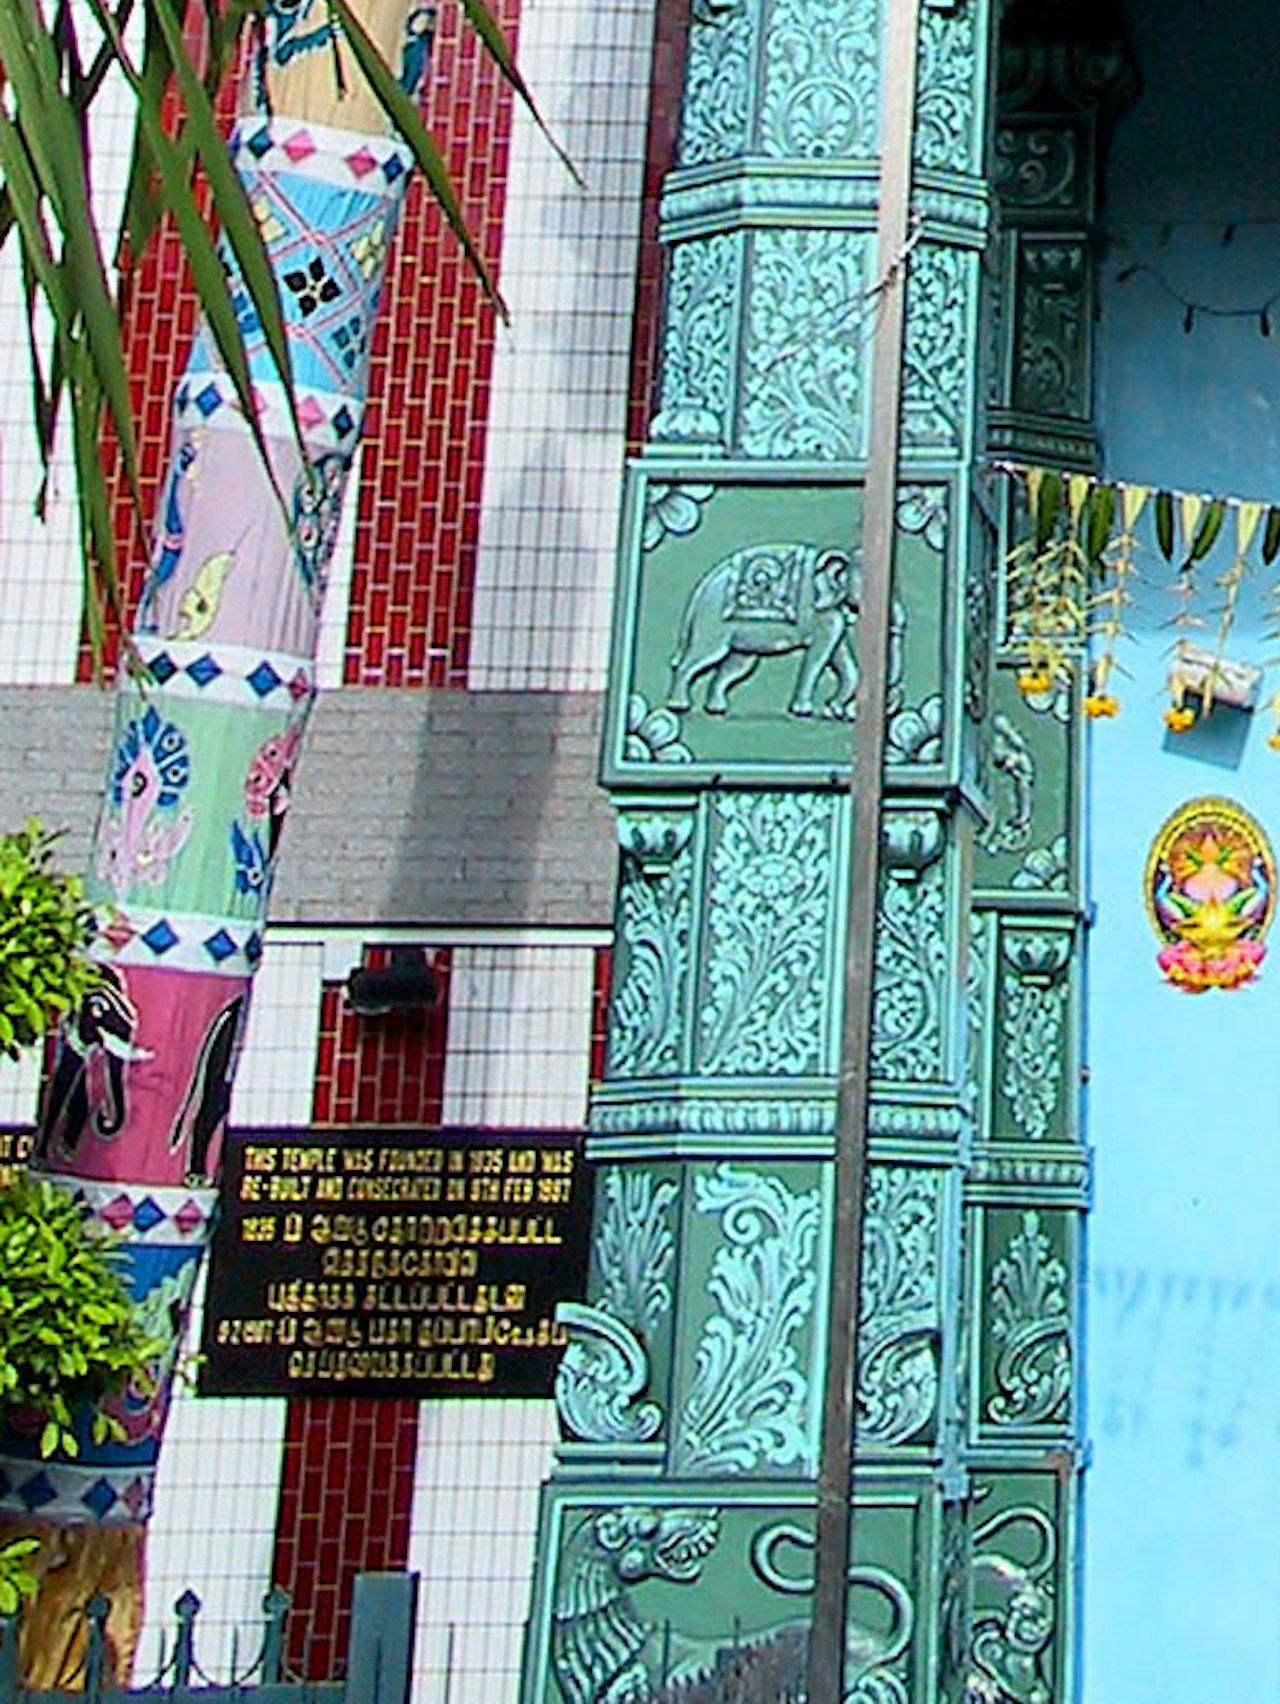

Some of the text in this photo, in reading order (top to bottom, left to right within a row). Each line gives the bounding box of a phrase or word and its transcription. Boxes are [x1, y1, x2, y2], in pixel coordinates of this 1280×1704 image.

[244, 1146, 278, 1172] THIS
[281, 1147, 338, 1172] TEMPLE
[342, 1147, 375, 1172] WAS
[378, 1147, 445, 1173] FOUNDED
[507, 1149, 537, 1173] AND
[541, 1149, 575, 1174] WAS
[315, 1176, 344, 1202] AND
